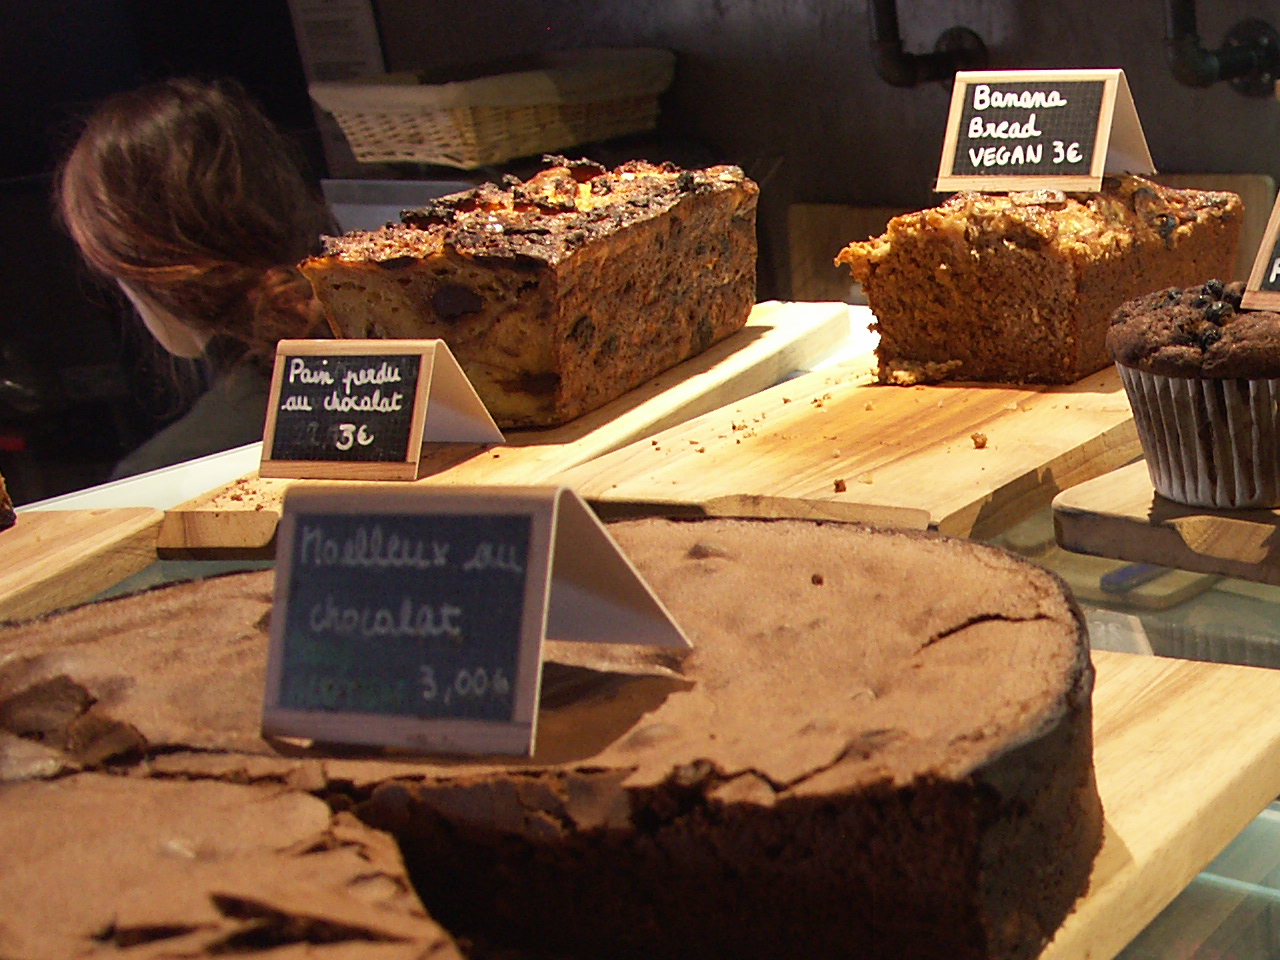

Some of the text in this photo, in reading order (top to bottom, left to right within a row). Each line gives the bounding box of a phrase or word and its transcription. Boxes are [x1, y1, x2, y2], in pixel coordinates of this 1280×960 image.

[973, 84, 1068, 110] Banana
[968, 113, 1042, 139] Bread
[969, 140, 1083, 167] VEGAN 3€
[289, 358, 402, 395] Pain perdu
[281, 390, 404, 412] au chocolat
[335, 424, 375, 451] 3€
[300, 525, 523, 573] Moelleux au
[310, 597, 462, 637] chocolat
